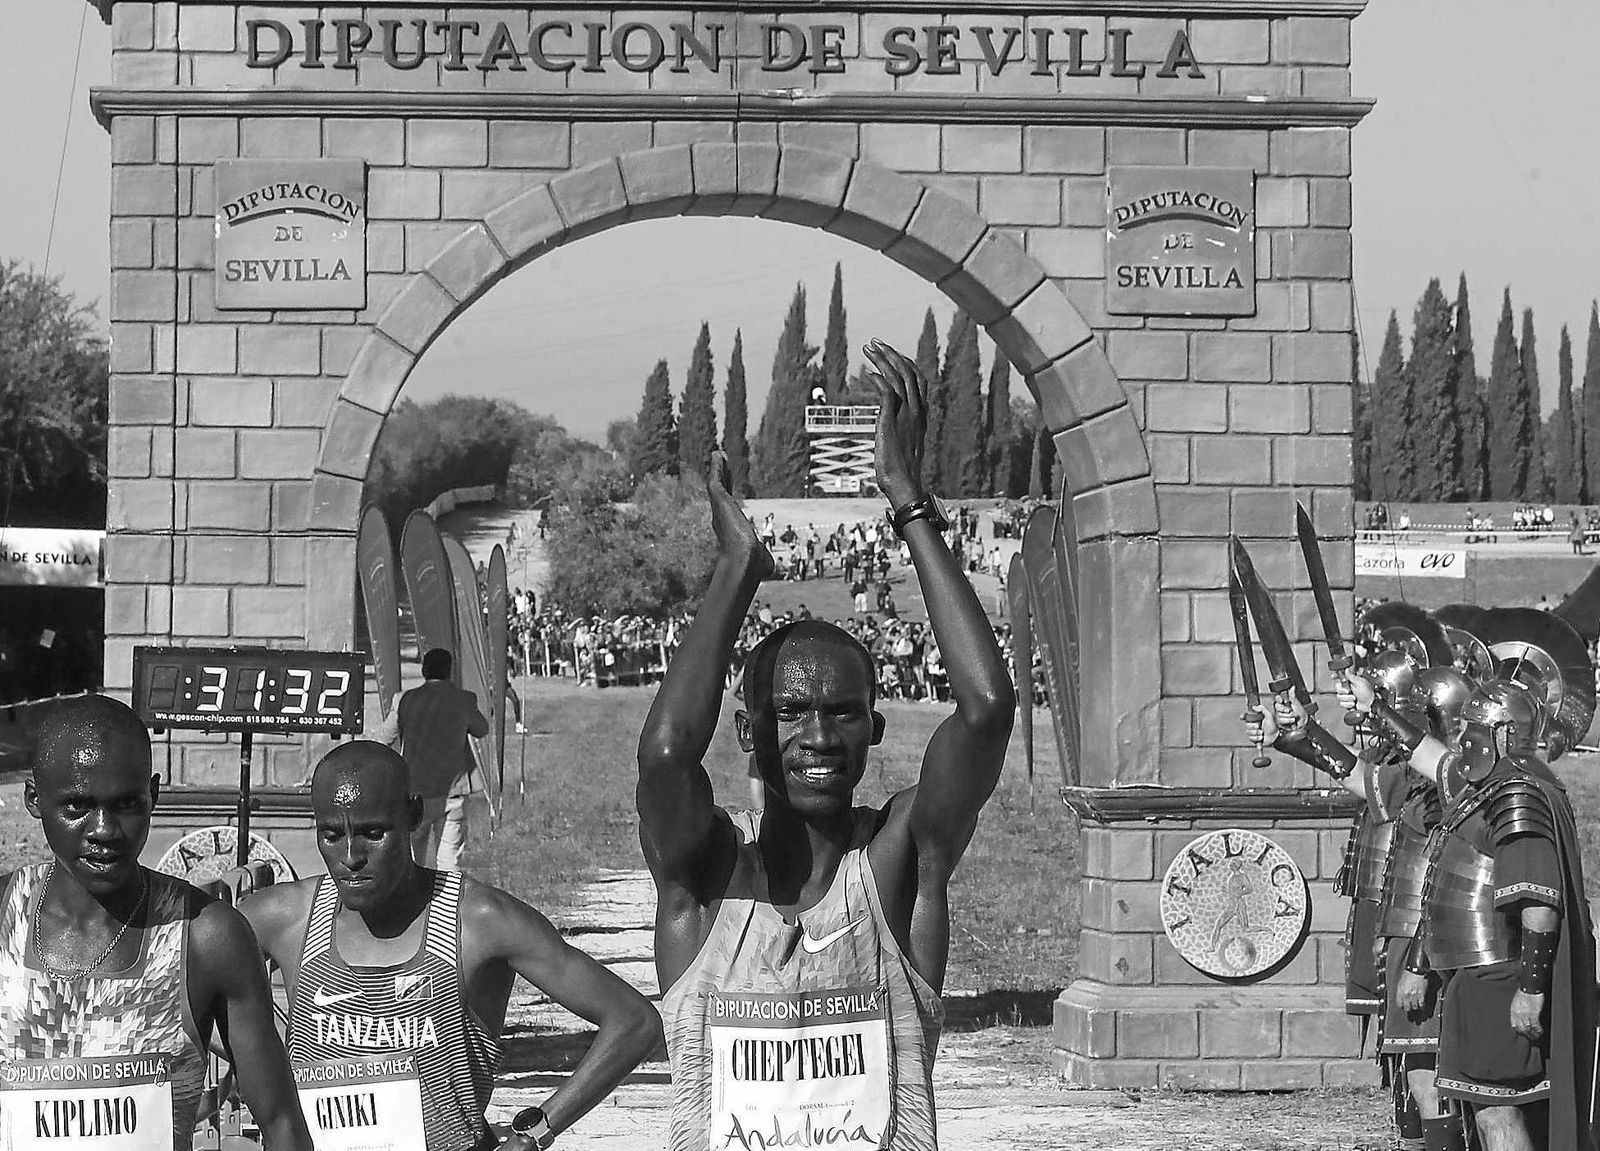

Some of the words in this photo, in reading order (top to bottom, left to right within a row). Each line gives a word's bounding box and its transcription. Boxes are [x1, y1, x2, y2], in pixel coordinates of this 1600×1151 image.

[245, 18, 724, 72] DIPUTACION
[761, 24, 846, 72] DE
[883, 24, 1206, 79] SEVILLA
[222, 183, 361, 221] DIPUTACION
[1113, 191, 1248, 226] DIPUTACION
[274, 226, 303, 242] DE
[1164, 234, 1194, 249] DE
[225, 258, 352, 282] SEVILLA
[1116, 265, 1244, 289] SEVILLA
[12, 552, 29, 563] DE
[35, 552, 92, 565] SEVILLA
[1420, 552, 1456, 569] evo
[1167, 833, 1302, 933] ITALICA
[715, 999, 801, 1020] DIPUTACION
[803, 998, 822, 1018] DE
[826, 991, 879, 1016] SEVILLA
[311, 1013, 439, 1049] TANZANIA
[6, 1064, 88, 1083] DIPUTACION
[92, 1063, 110, 1080] DE
[114, 1058, 166, 1079] SEVILLA
[348, 1063, 364, 1078] DE
[366, 1058, 415, 1076] SEVILLA
[732, 1034, 867, 1082] CHEPTEGEI
[34, 1096, 137, 1138] KIPLIMO
[724, 1109, 878, 1151] Andalucía
